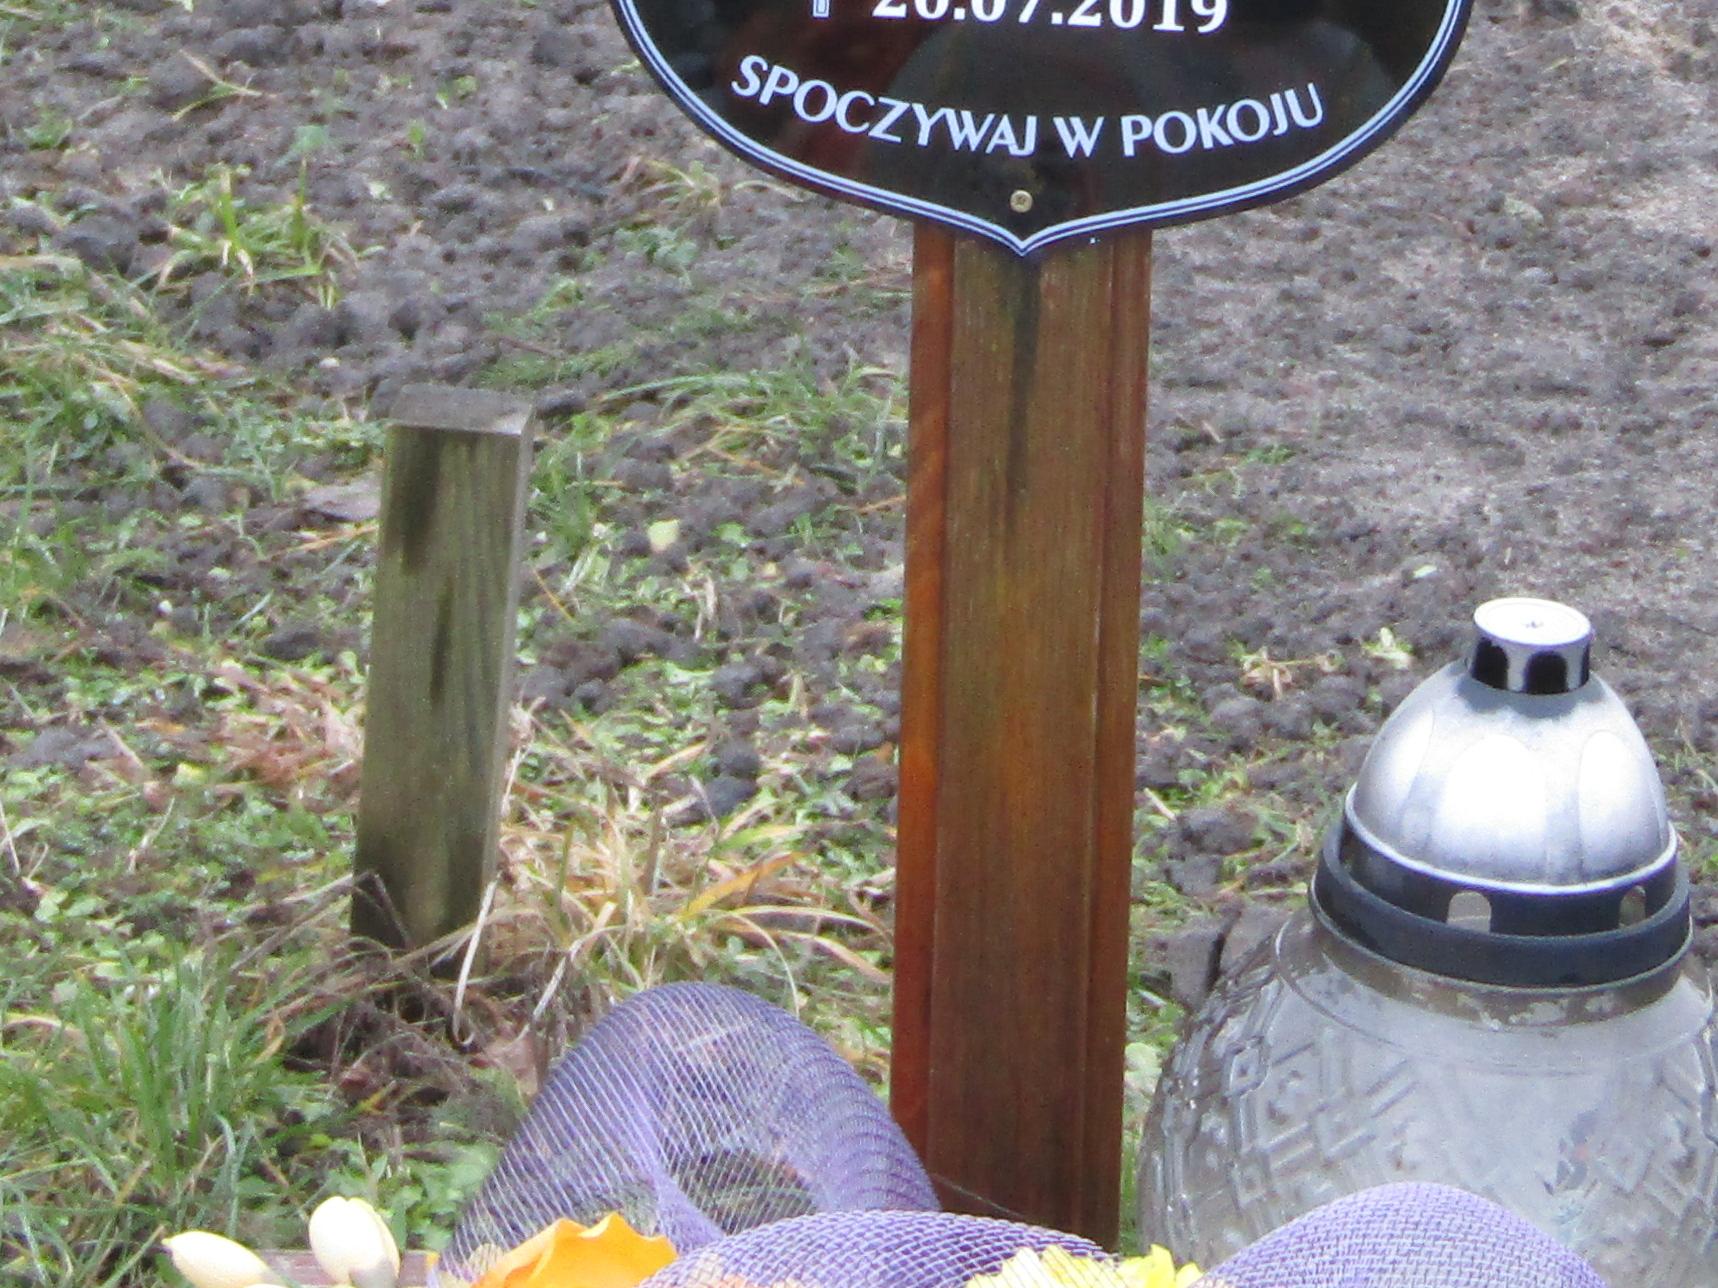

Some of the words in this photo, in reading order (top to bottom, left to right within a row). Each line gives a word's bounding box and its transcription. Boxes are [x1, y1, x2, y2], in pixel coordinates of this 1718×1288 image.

[731, 55, 1037, 156] SPOCZYWAJ
[1052, 116, 1105, 158] W
[1121, 83, 1324, 157] POKOJU
